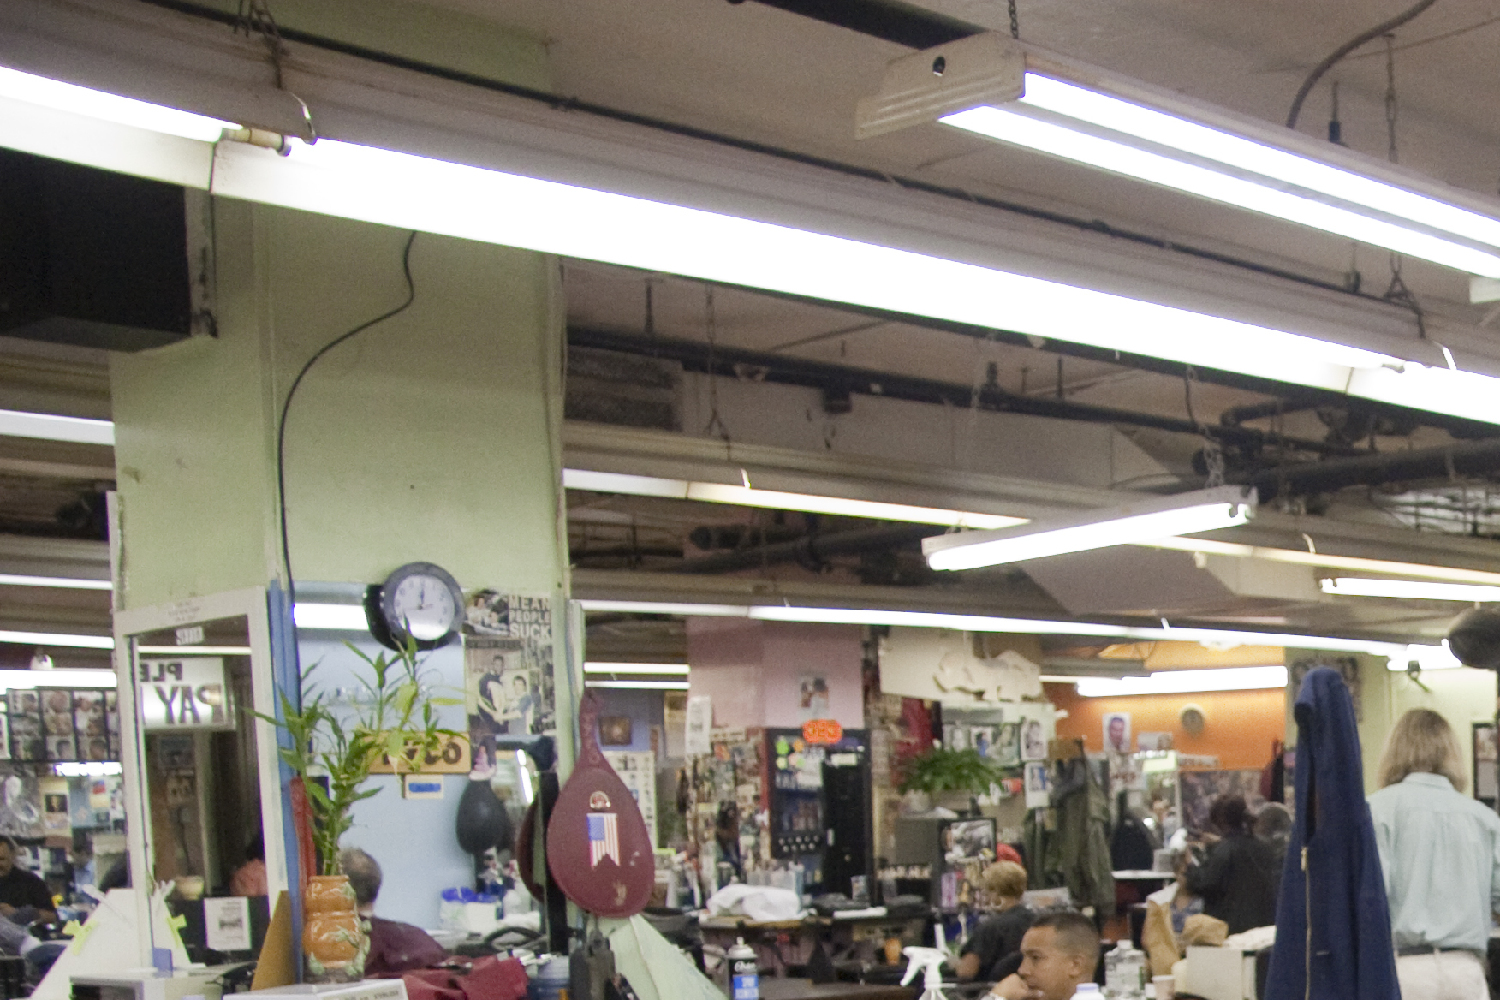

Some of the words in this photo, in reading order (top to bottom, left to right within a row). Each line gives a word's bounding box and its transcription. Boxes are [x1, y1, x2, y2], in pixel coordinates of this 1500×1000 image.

[509, 595, 551, 611] MEAN
[509, 610, 551, 624] PEOPLE
[509, 623, 551, 641] SUCK
